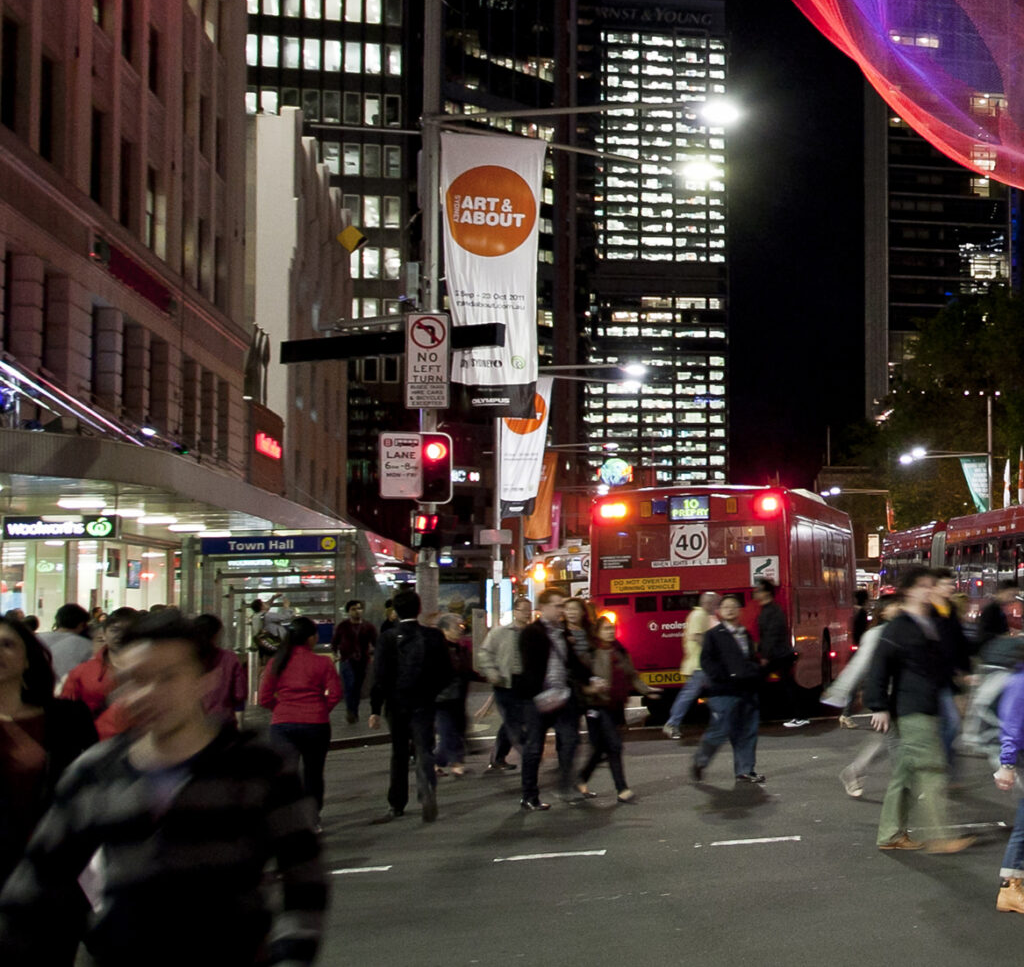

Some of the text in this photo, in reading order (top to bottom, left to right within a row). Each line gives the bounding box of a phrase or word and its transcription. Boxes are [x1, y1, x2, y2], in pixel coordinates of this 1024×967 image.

[641, 10, 652, 22] &
[655, 8, 712, 25] YOUNG
[461, 195, 513, 213] ART &
[460, 210, 526, 228] ABOUT
[493, 293, 507, 301] Oct
[417, 352, 438, 362] NO
[413, 365, 442, 373] LEFT
[413, 375, 443, 383] TURN
[386, 451, 417, 460] LANE
[683, 498, 699, 509] 10
[671, 508, 709, 517] PREPAY
[228, 539, 294, 551] Town Hall
[675, 533, 703, 551] 40
[641, 577, 677, 585] OVERTAKE
[647, 583, 675, 591] VEHICLE
[648, 673, 682, 683] LONG
